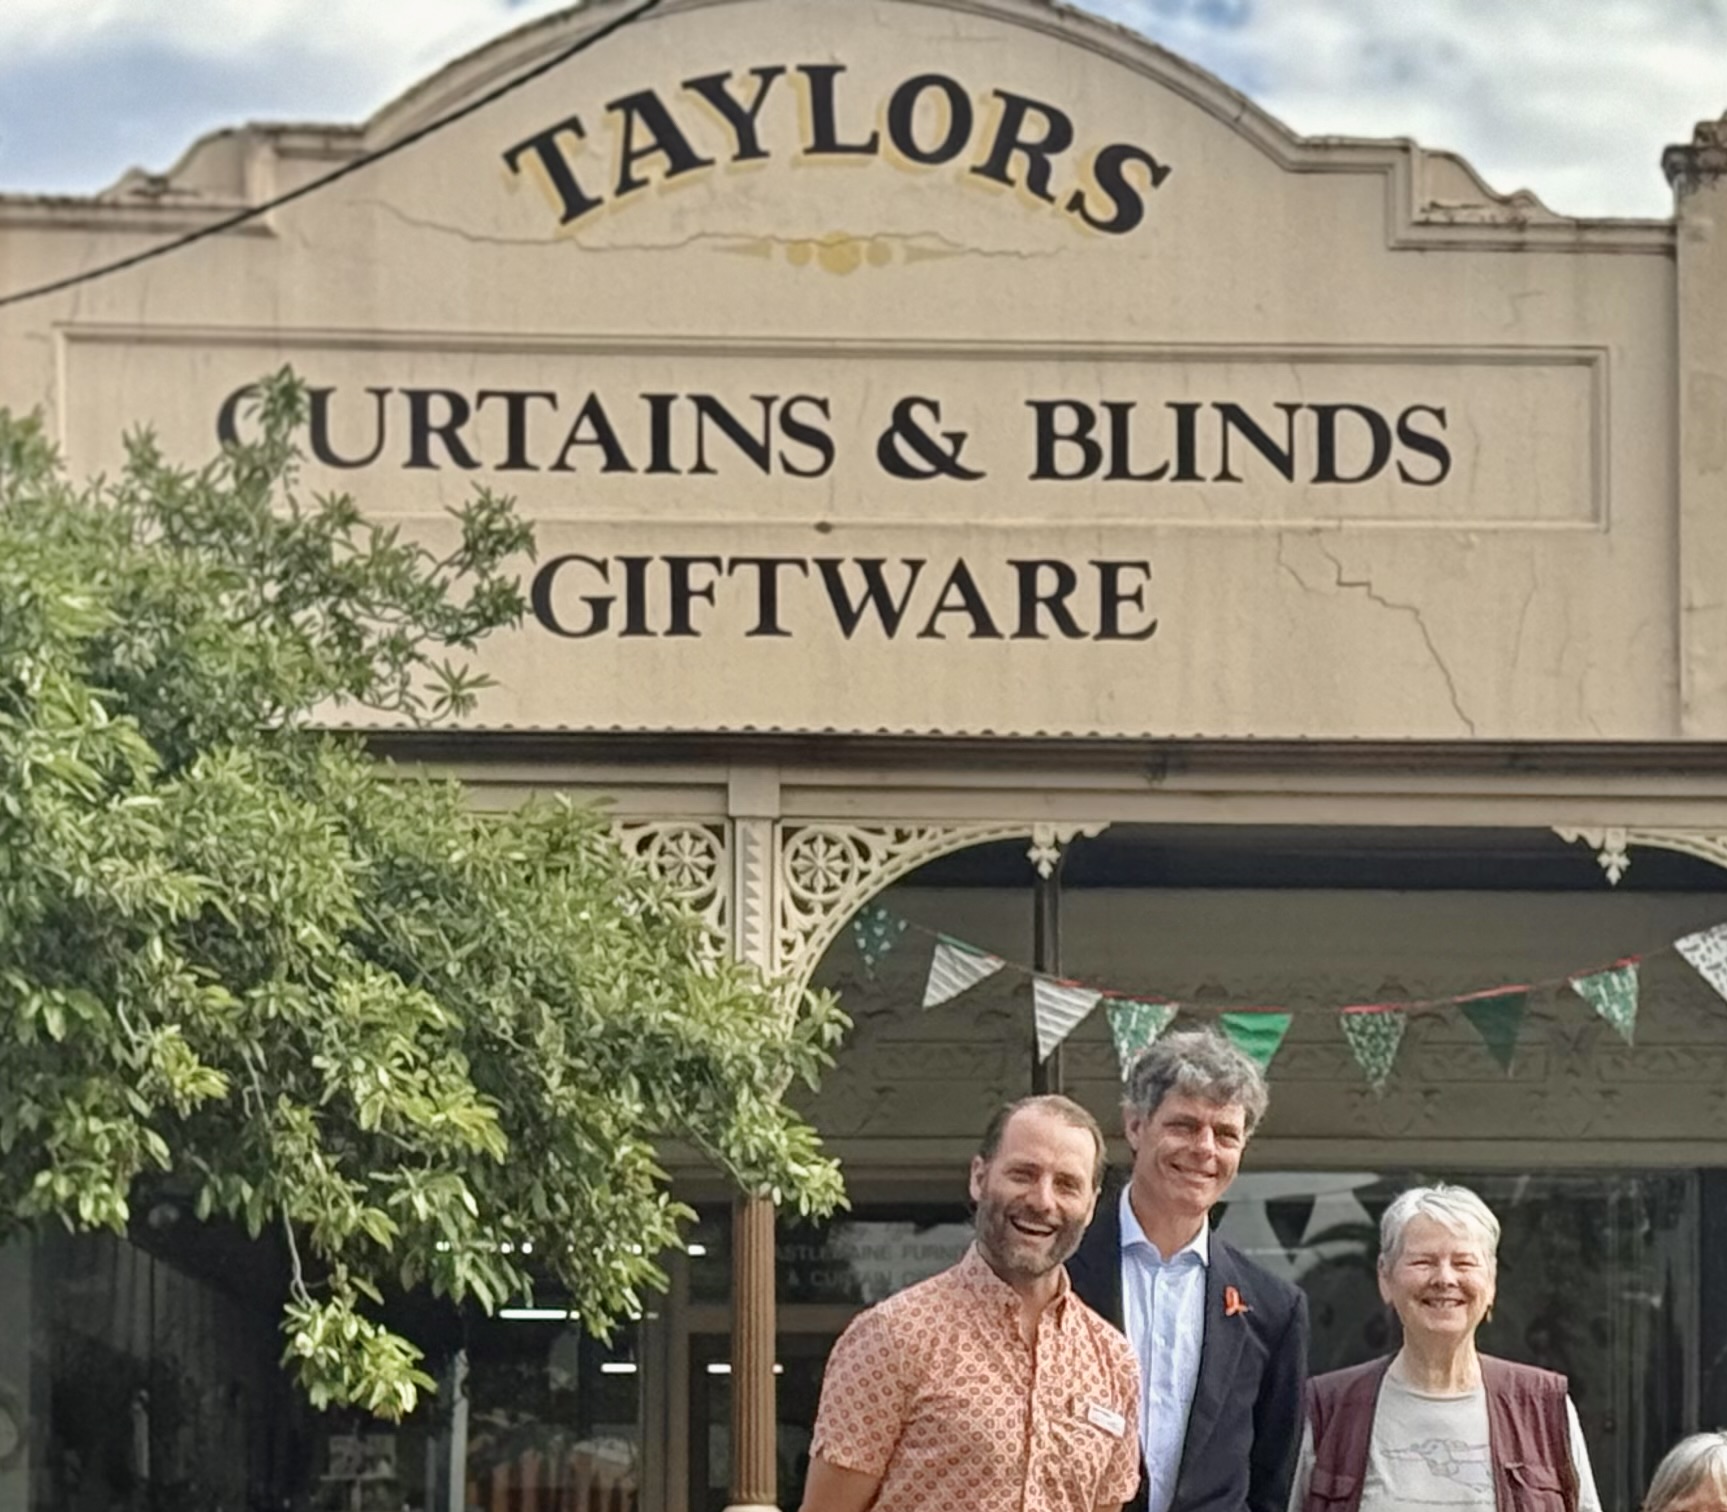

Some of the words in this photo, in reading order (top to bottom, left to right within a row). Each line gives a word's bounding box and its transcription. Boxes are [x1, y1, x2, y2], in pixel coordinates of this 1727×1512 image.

[502, 62, 1171, 235] TAYLORS
[216, 382, 835, 481] CURTAINS
[875, 395, 987, 483] &
[1026, 399, 1453, 487] BLINDS
[530, 553, 1159, 642] GIFTWARE
